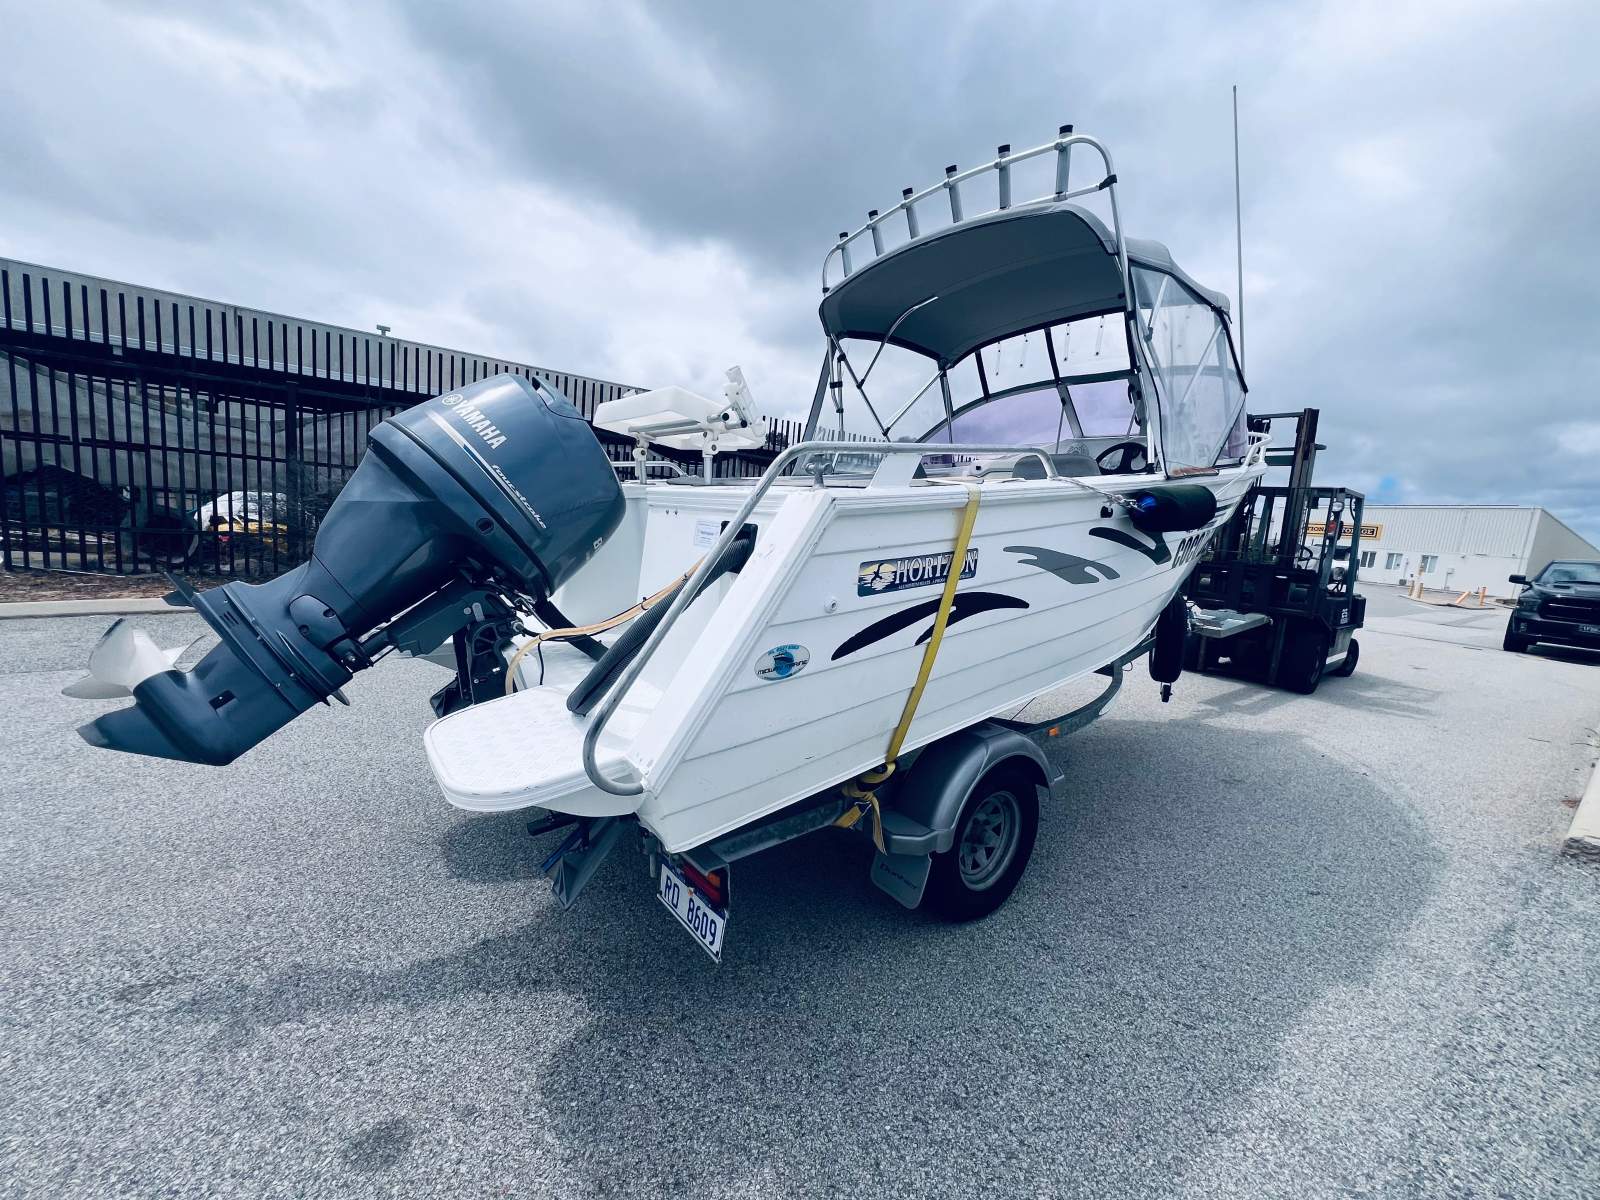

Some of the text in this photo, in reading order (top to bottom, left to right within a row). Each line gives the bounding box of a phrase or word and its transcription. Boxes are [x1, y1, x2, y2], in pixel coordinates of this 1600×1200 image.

[452, 401, 507, 450] YAMAHA
[894, 551, 978, 585] HORIZN
[664, 874, 680, 910] RD
[686, 897, 718, 946] 8609
